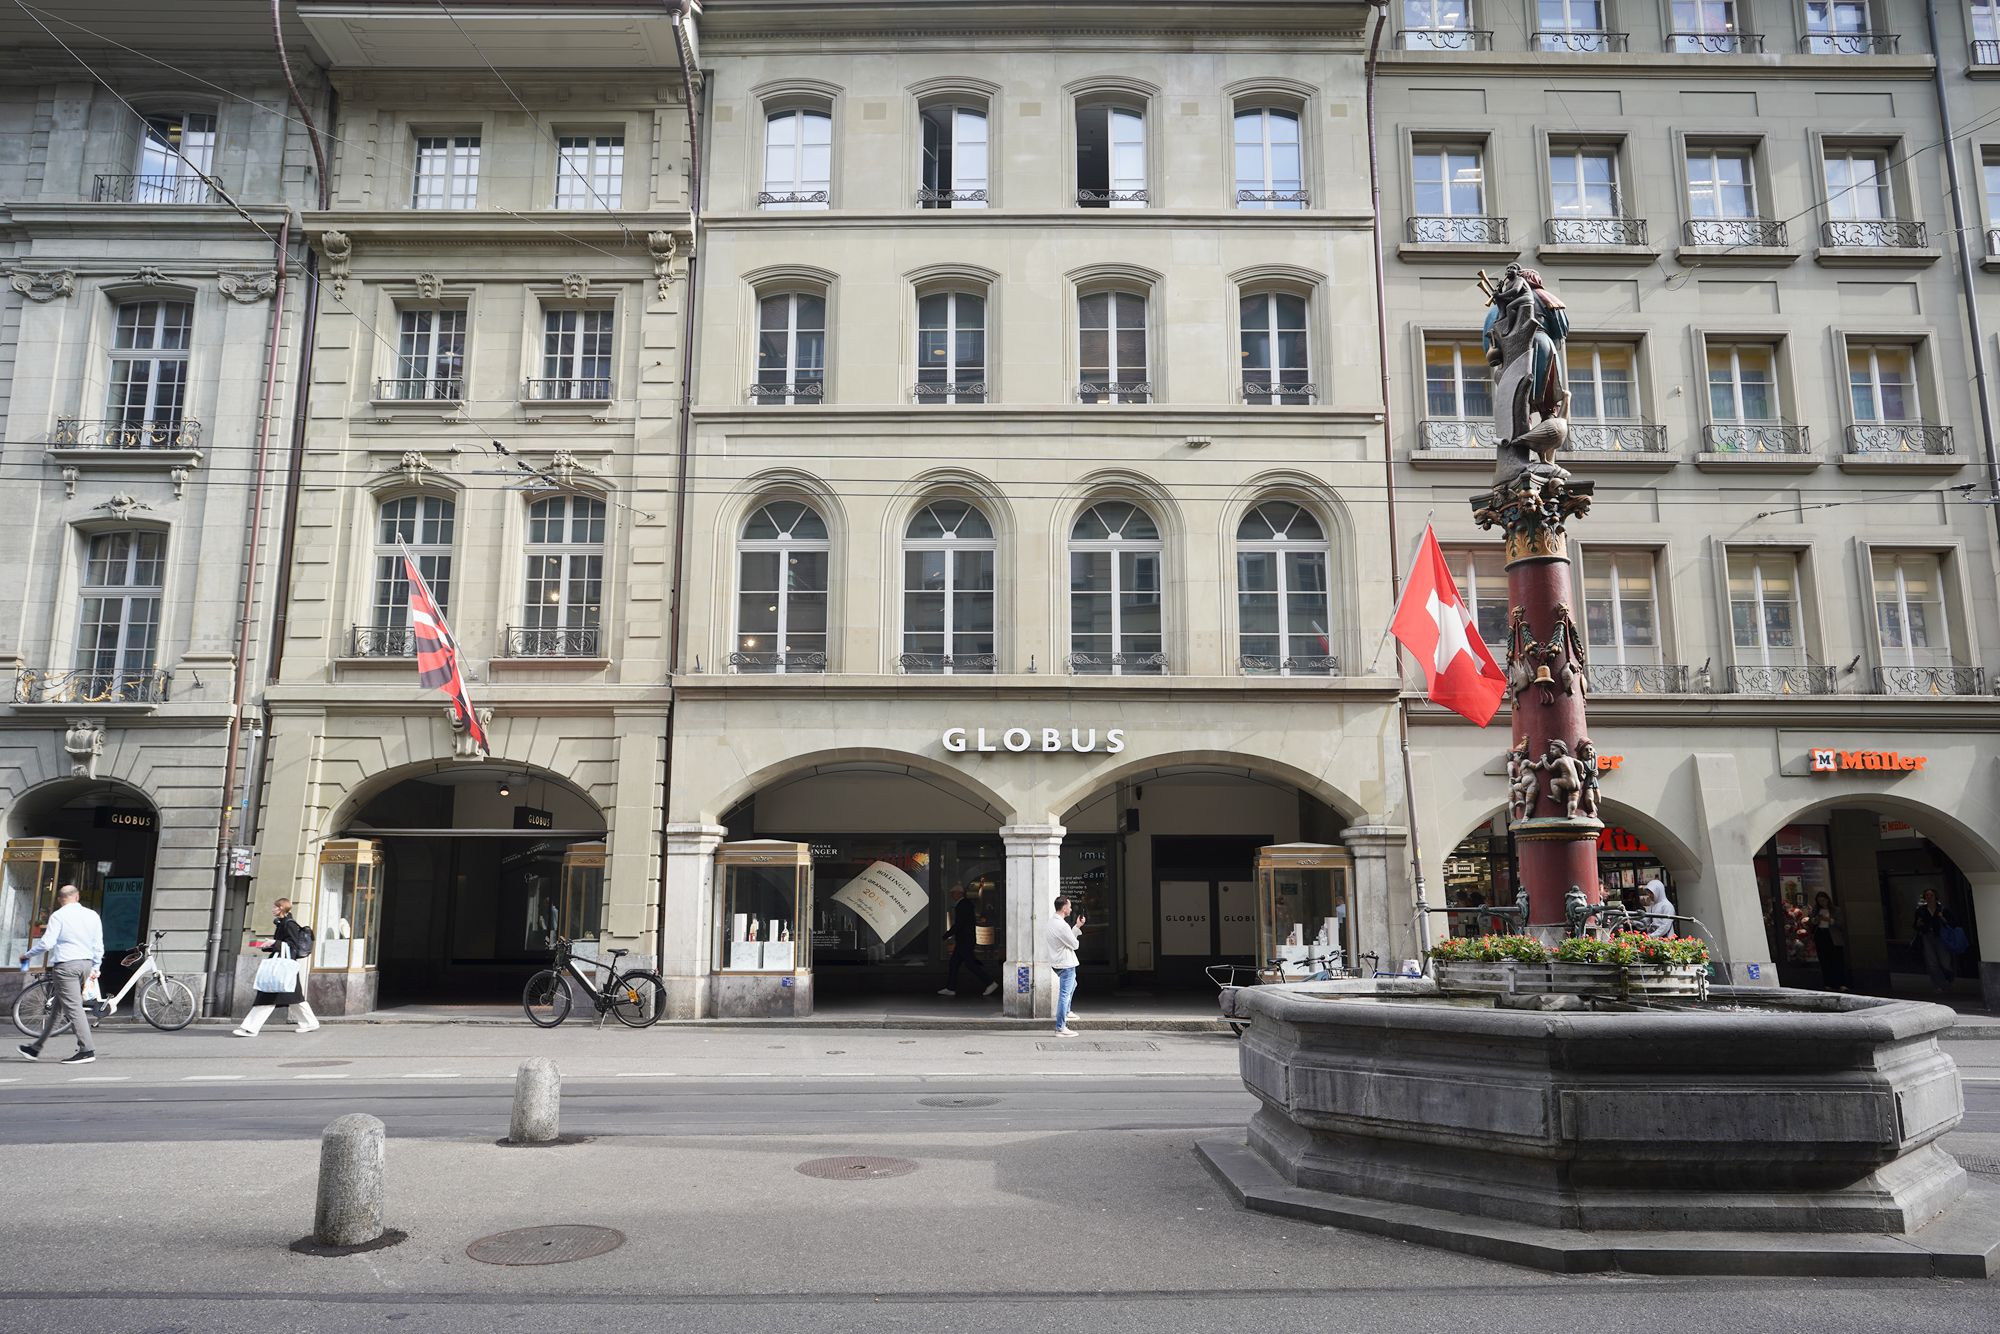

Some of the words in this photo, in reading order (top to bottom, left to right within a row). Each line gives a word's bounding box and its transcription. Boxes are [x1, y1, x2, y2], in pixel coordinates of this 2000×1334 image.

[943, 727, 1125, 753] GLOBUS
[1819, 755, 1831, 765] M
[1840, 751, 1927, 770] Müller
[112, 814, 151, 826] GLOBUS
[528, 814, 551, 827] GLOBUS
[107, 881, 125, 892] NOW
[126, 881, 143, 892] NEW
[867, 878, 891, 896] GRANDE
[876, 869, 912, 897] BOLLINGER
